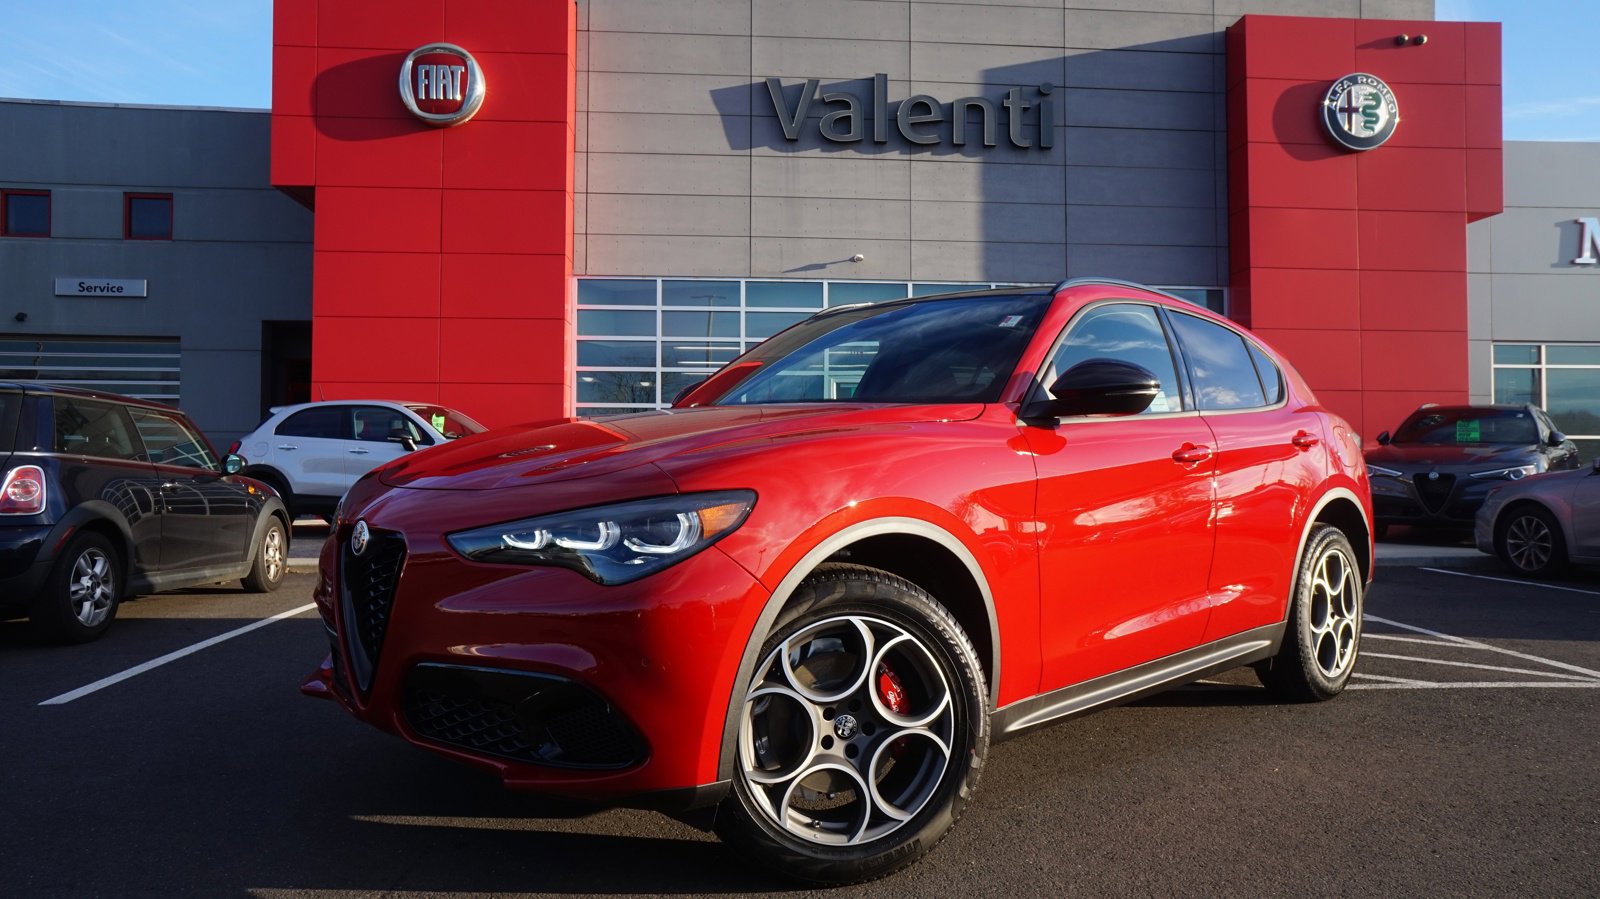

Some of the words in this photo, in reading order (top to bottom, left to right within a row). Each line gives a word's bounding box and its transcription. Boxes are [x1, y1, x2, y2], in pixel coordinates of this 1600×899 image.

[417, 64, 465, 101] FIAT
[1328, 79, 1353, 111] ALFA
[1357, 75, 1396, 114] ROMEO
[765, 73, 1054, 149] Valenti
[78, 281, 124, 293] Service
